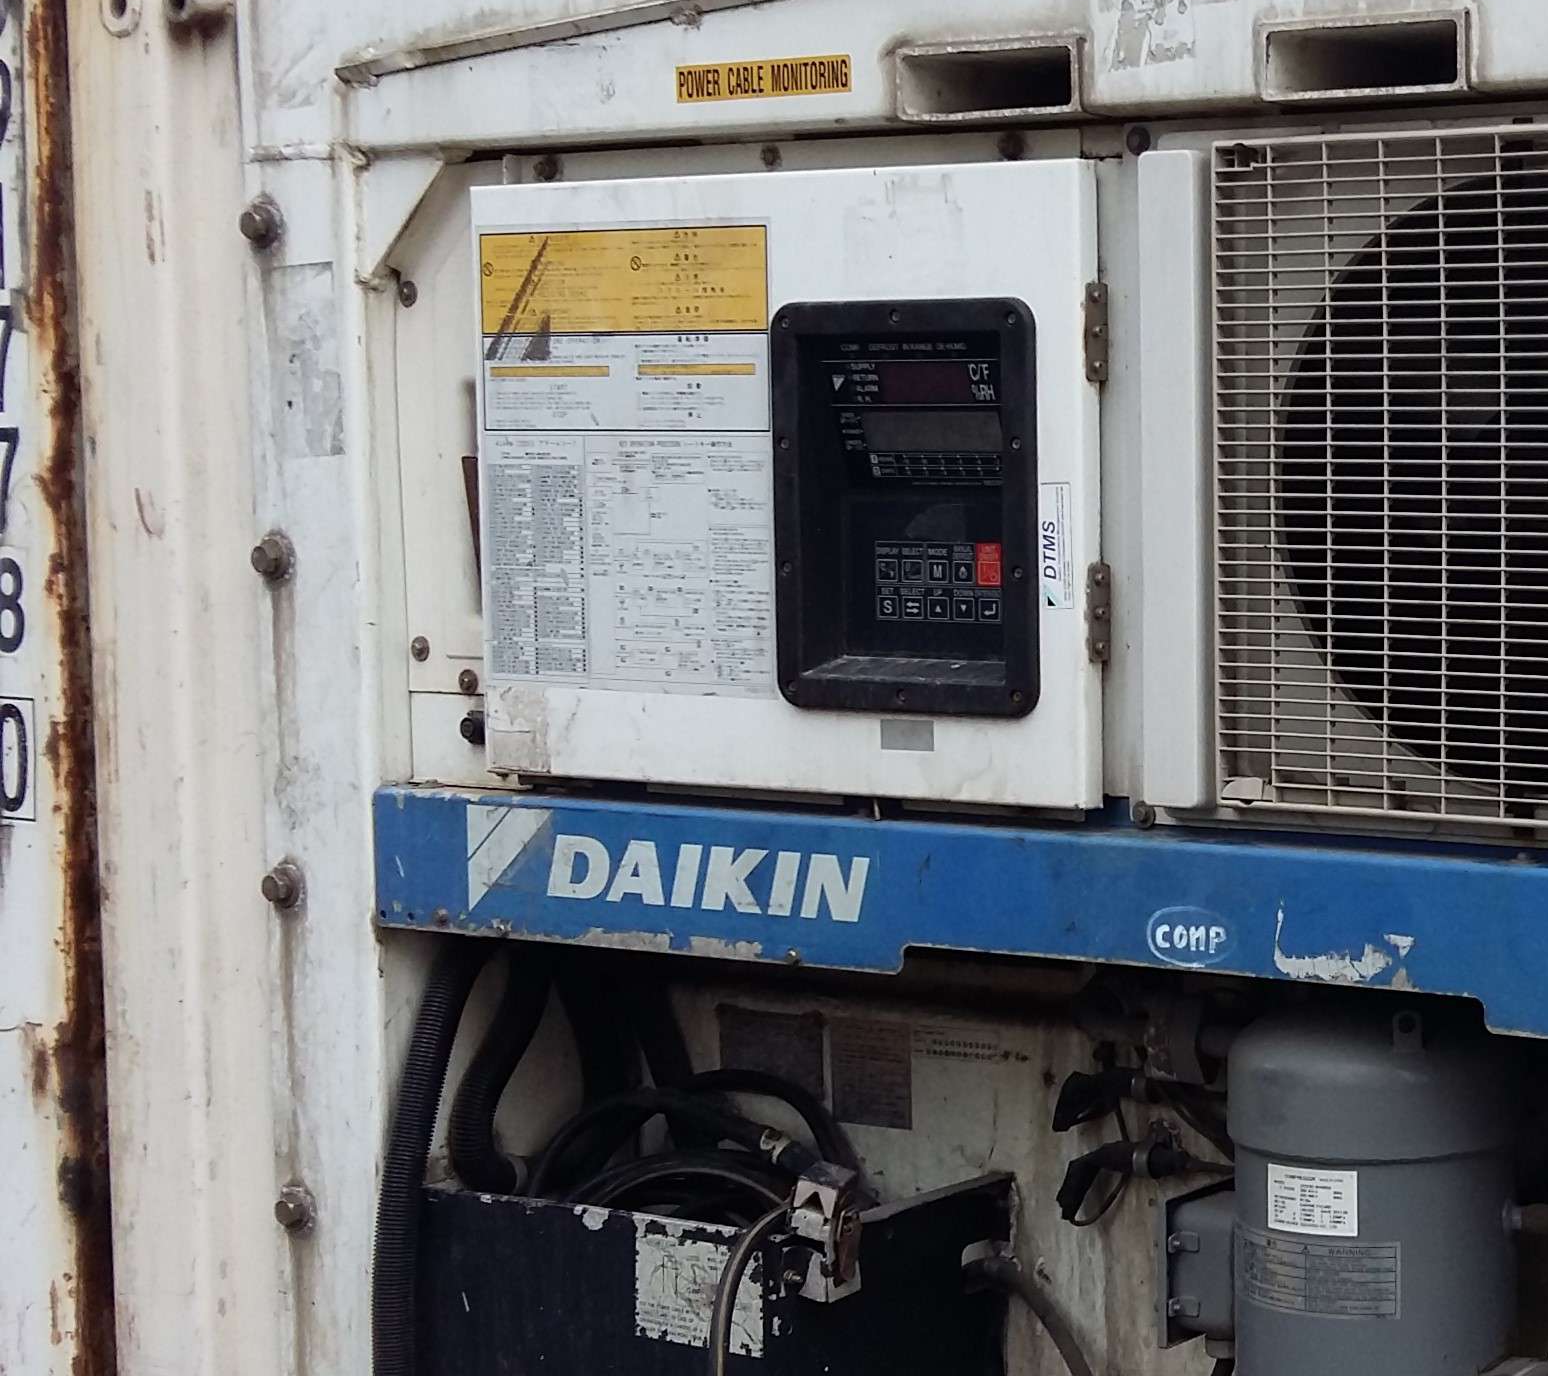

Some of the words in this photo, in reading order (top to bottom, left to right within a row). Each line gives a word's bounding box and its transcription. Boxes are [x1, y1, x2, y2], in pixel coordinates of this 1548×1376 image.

[679, 69, 721, 98] POWER
[727, 65, 765, 96] CABLE
[771, 59, 848, 92] MONITORING
[1042, 521, 1057, 579] DTMS
[933, 565, 942, 577] M
[883, 601, 893, 613] S
[546, 834, 870, 923] DAIKIN
[1155, 924, 1227, 954] COMP
